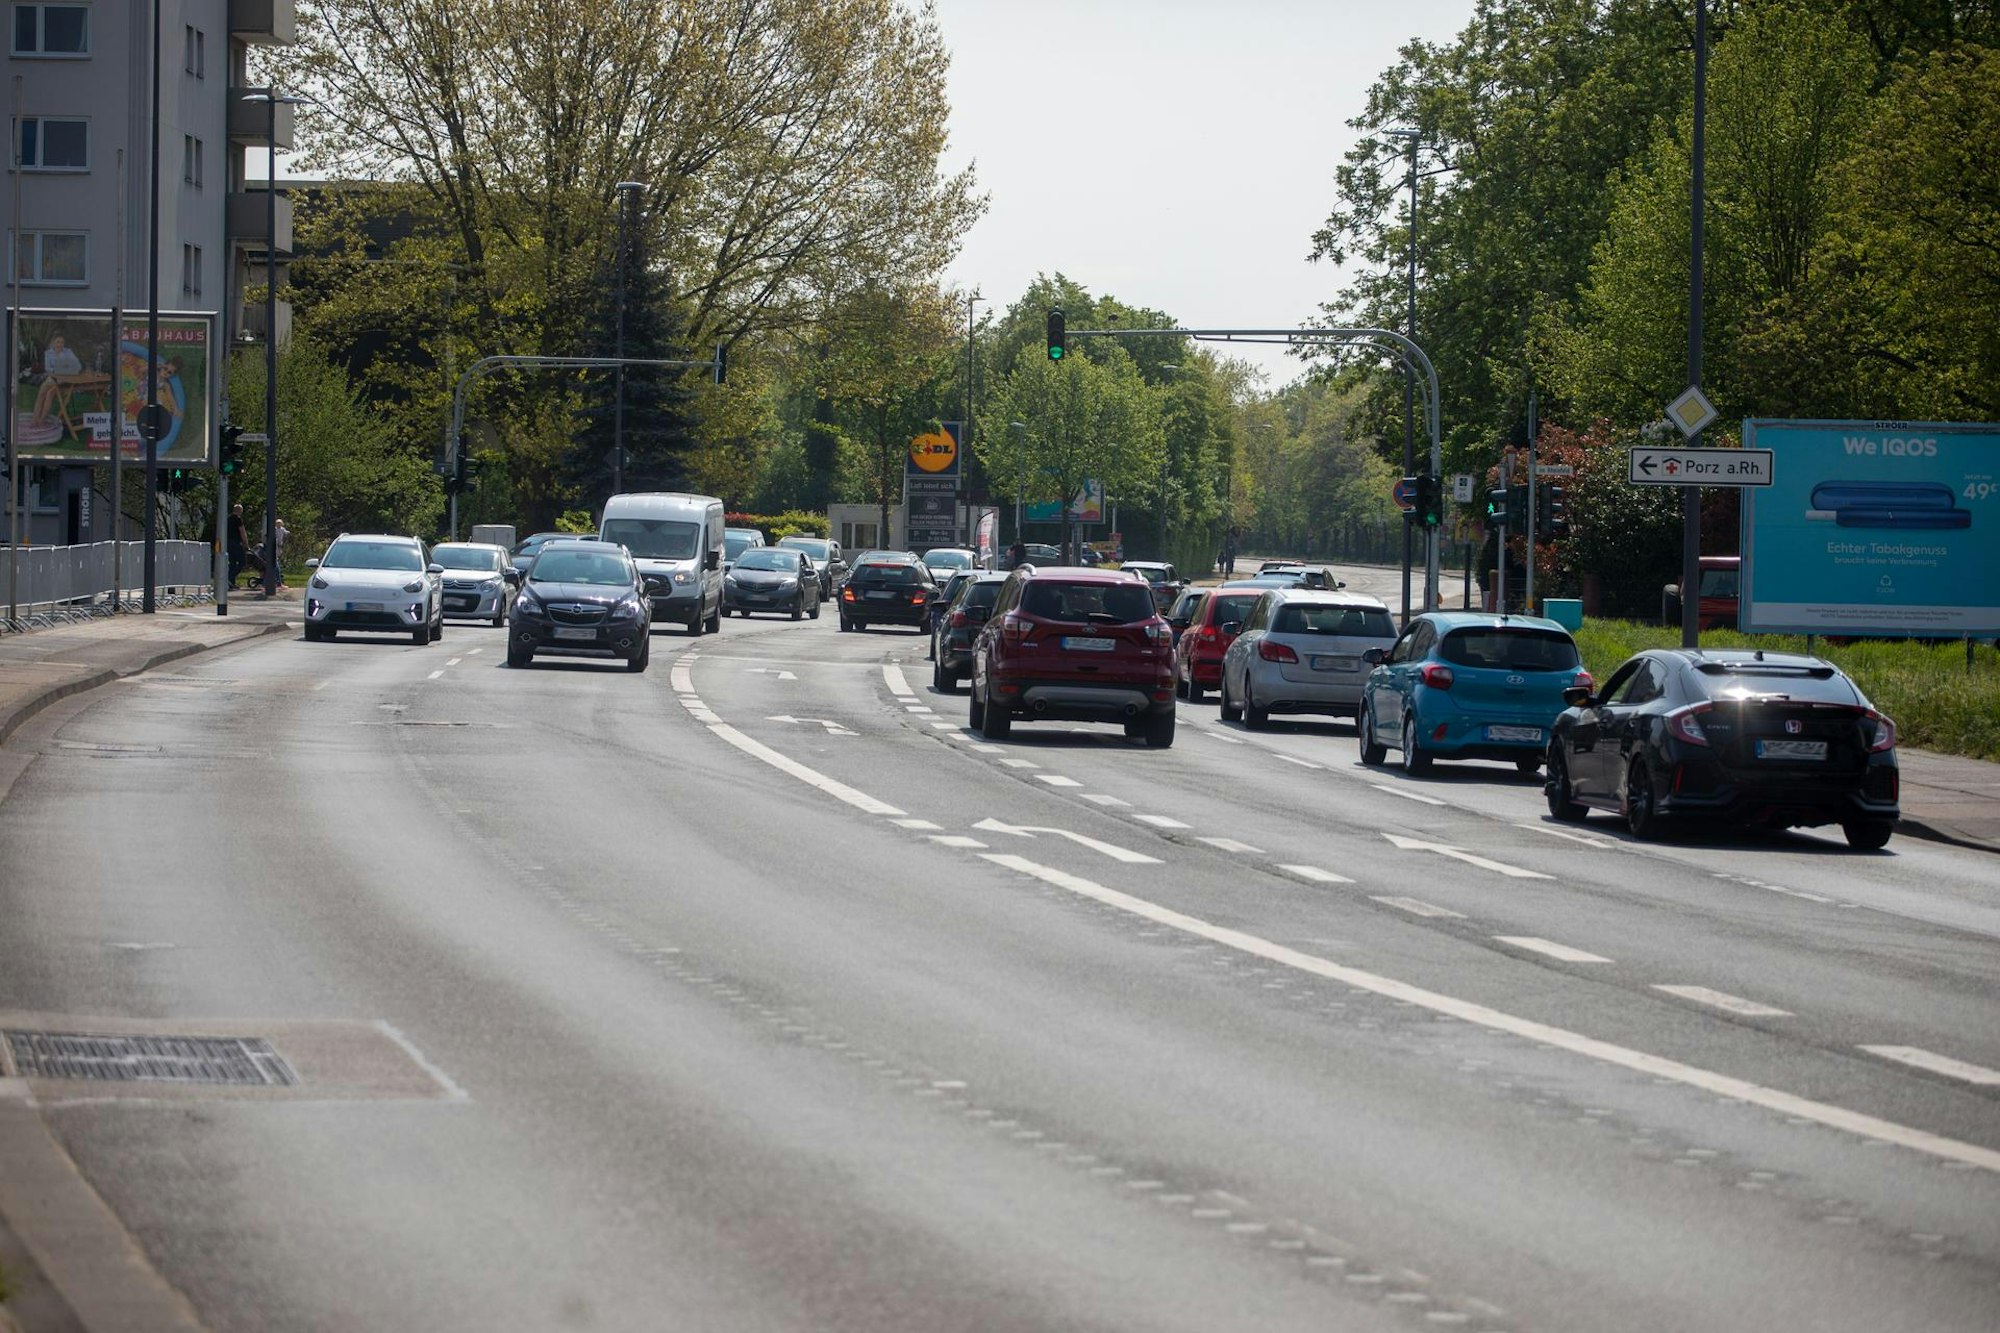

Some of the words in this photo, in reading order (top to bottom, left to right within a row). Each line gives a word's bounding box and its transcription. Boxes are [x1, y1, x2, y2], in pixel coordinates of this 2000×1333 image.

[86, 415, 107, 424] Mehr
[1843, 437, 1878, 456] We
[1882, 438, 1937, 457] IQOS
[1685, 459, 1720, 474] Porz
[1726, 460, 1764, 476] a.Rh.
[1827, 542, 1867, 555] Echter
[1870, 543, 1948, 558] Tabakgenuss
